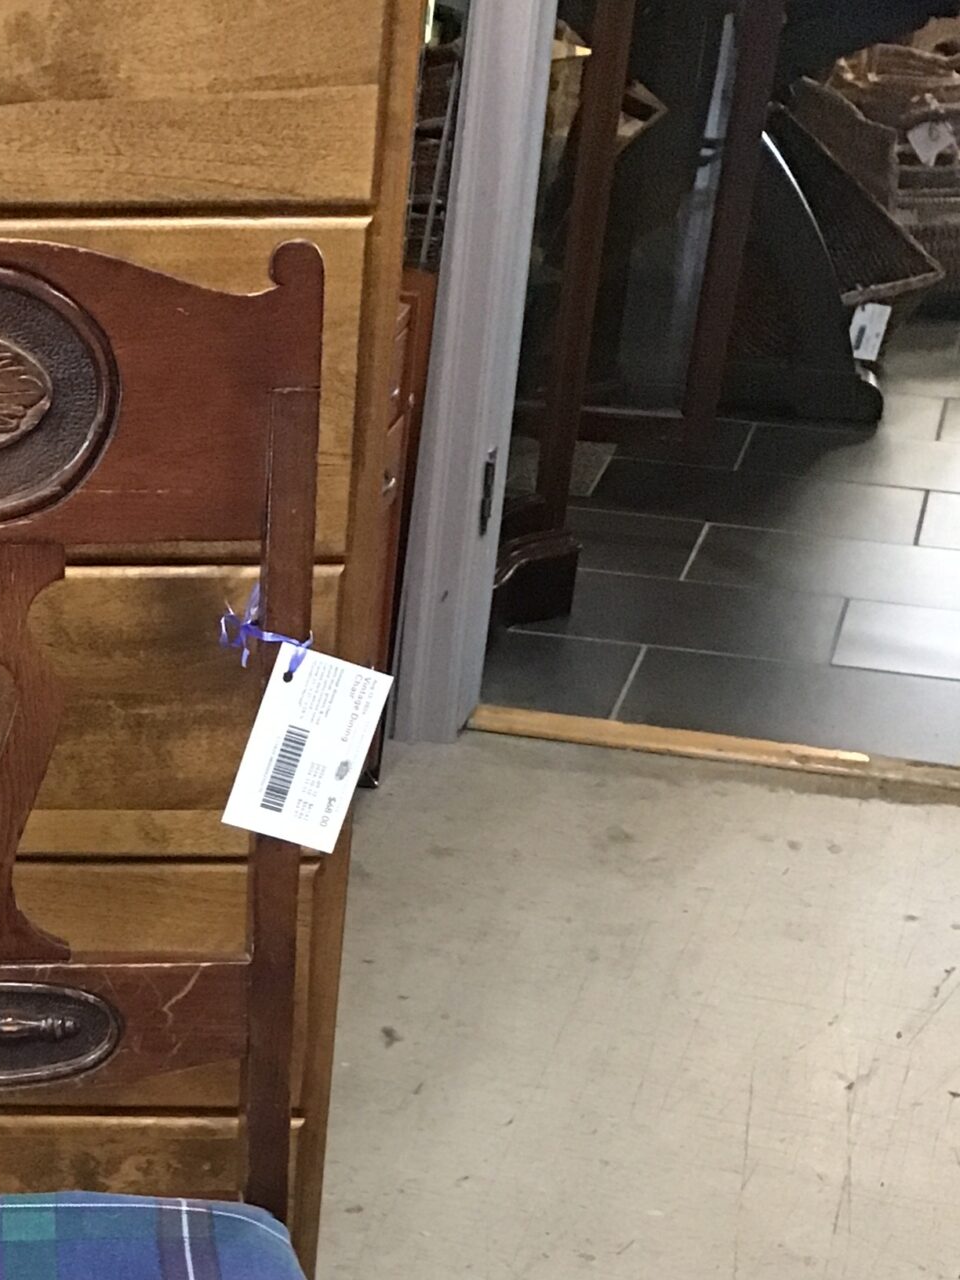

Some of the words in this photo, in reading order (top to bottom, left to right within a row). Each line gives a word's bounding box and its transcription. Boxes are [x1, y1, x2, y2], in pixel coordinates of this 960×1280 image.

[349, 674, 363, 699] Chair
[354, 677, 371, 711] Vintage
[340, 712, 359, 743] Dining
